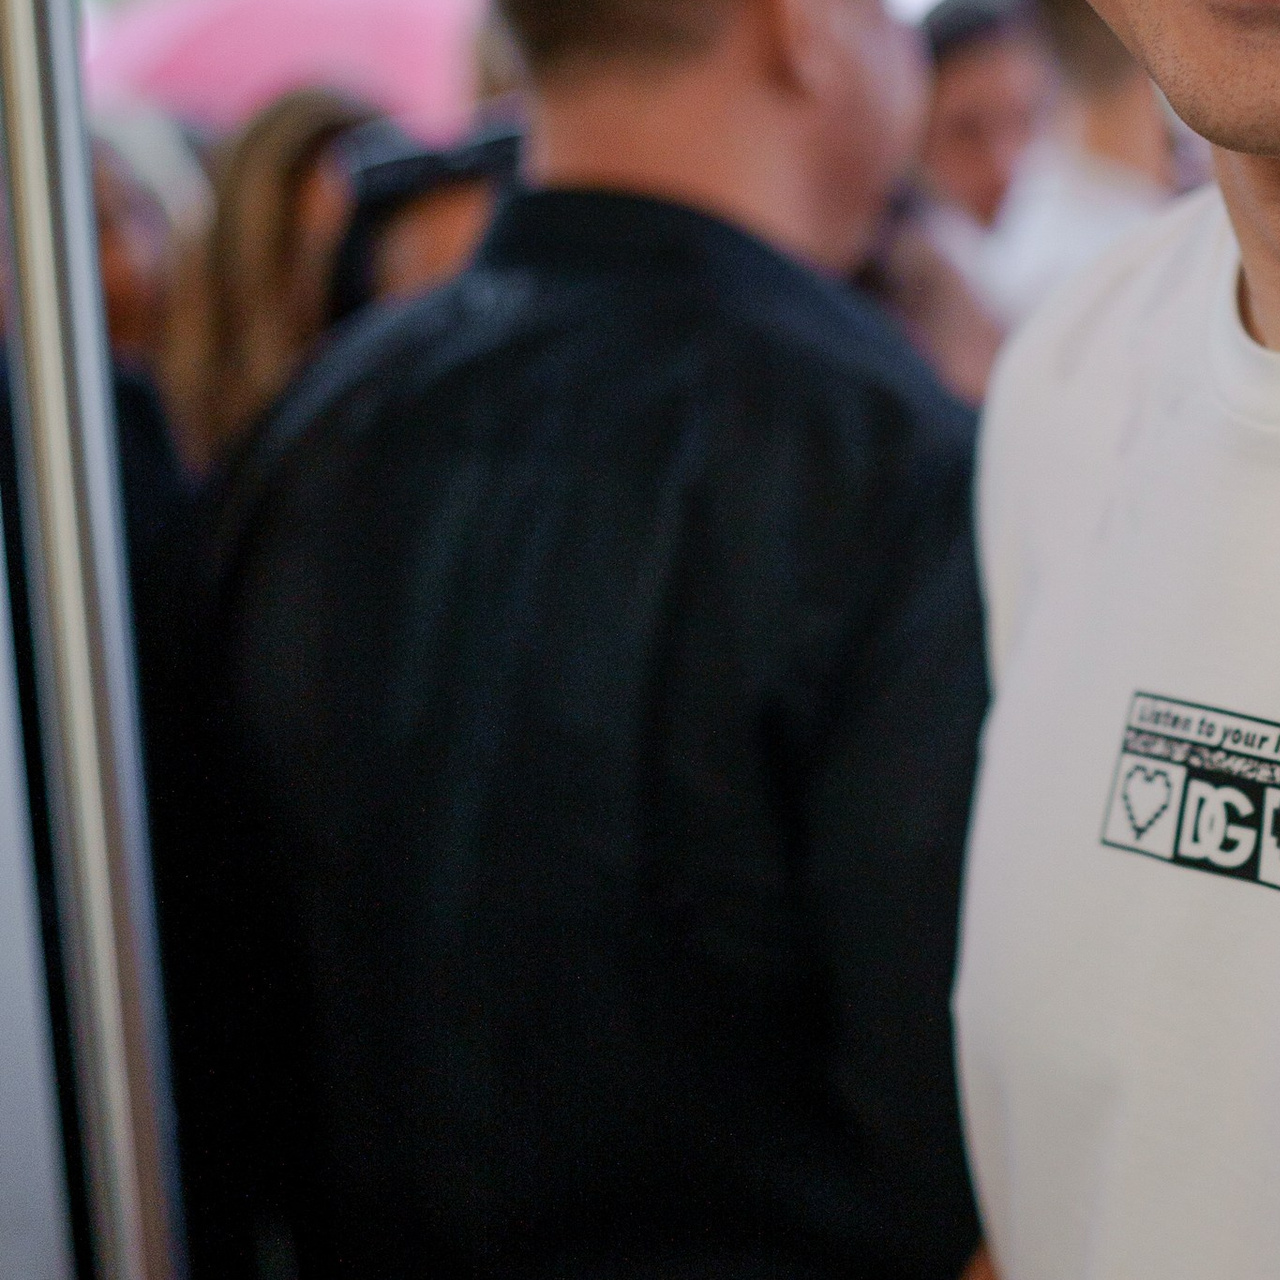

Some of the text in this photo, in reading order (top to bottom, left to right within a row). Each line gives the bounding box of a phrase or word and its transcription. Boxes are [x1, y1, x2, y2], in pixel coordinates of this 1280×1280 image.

[1137, 703, 1192, 732] Listen
[1197, 716, 1217, 739] to
[1218, 723, 1270, 751] your
[1177, 777, 1258, 869] DG
